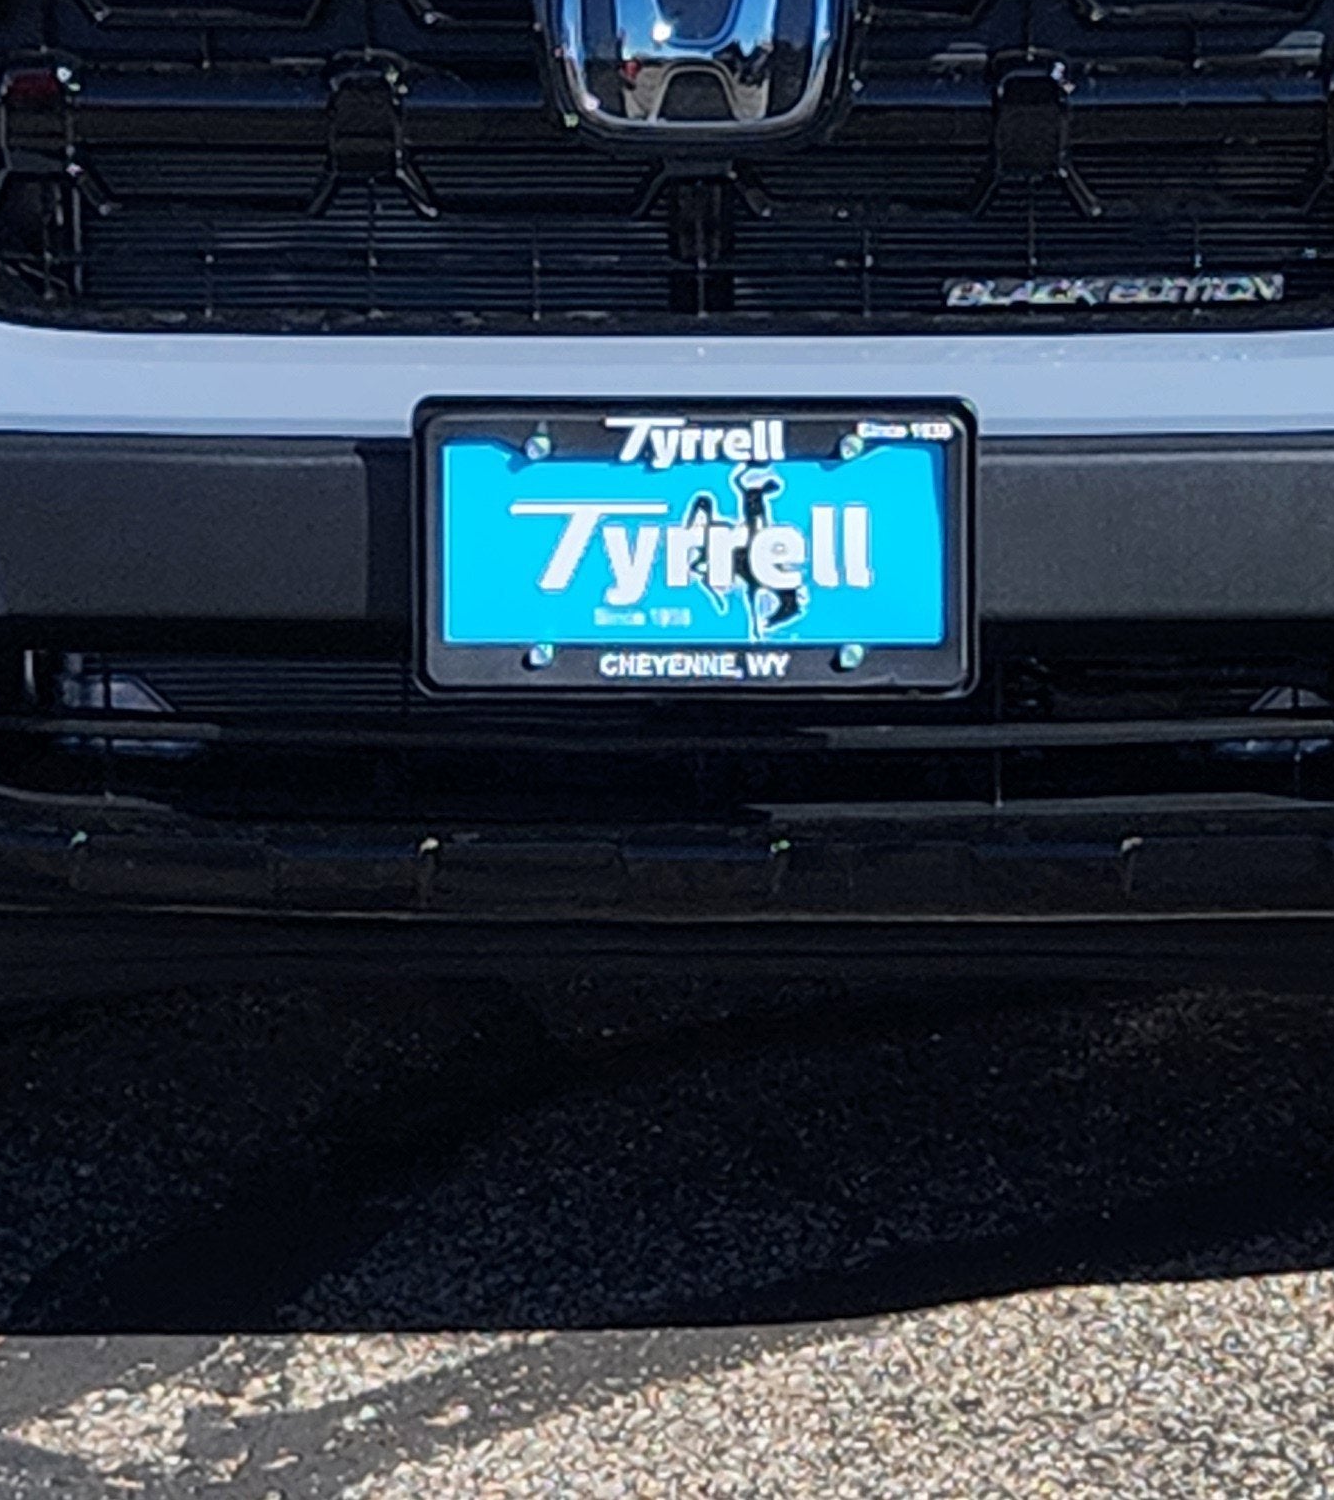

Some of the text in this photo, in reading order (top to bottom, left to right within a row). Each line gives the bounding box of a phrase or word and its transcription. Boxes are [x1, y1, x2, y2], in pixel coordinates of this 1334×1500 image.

[944, 274, 1285, 307] BLACK EDITION
[604, 416, 786, 468] Tyrrell
[508, 499, 875, 606] Tyrrell
[598, 652, 792, 680] CHEYENNE, WY
